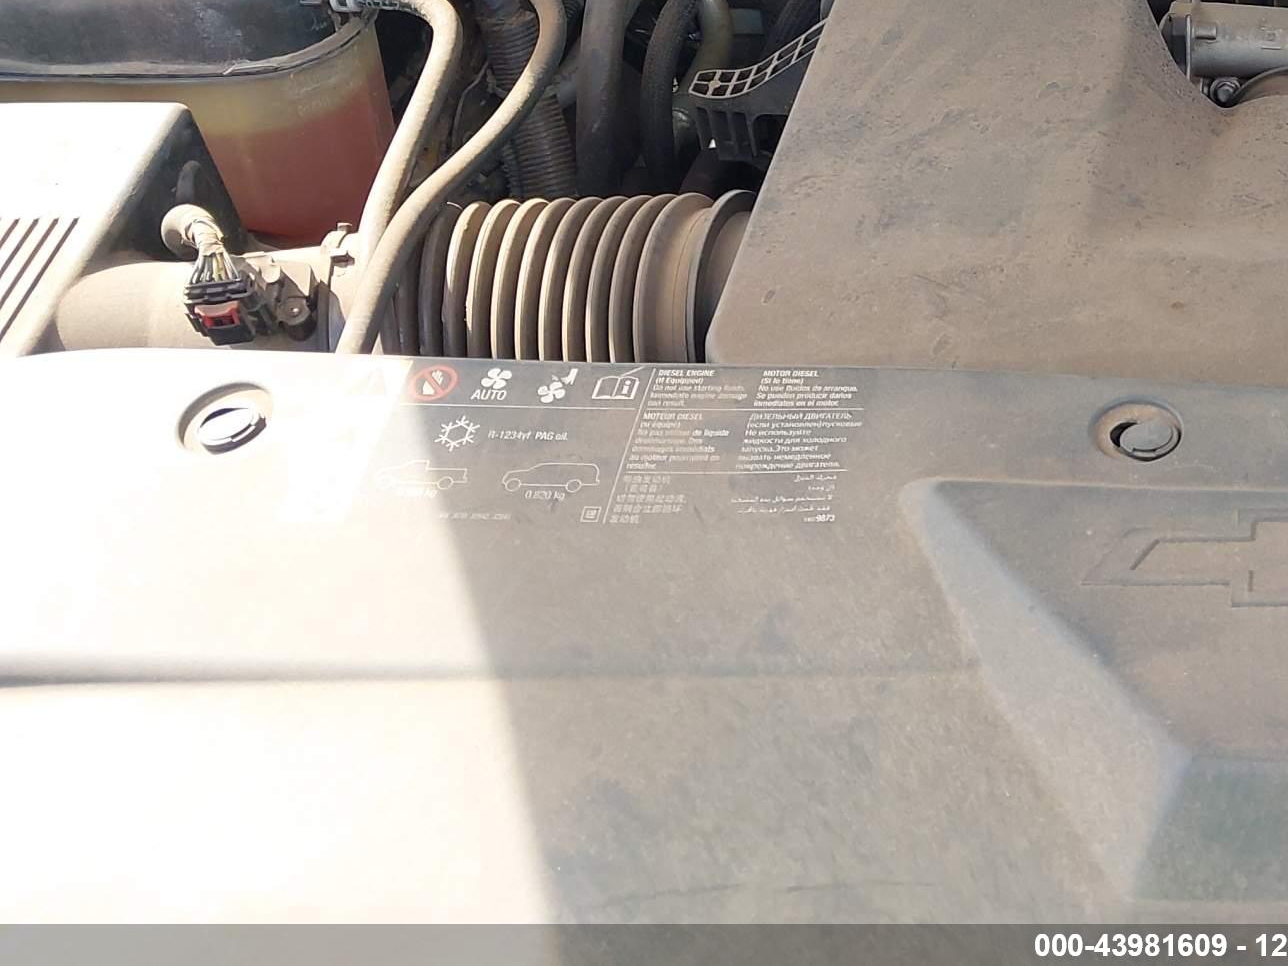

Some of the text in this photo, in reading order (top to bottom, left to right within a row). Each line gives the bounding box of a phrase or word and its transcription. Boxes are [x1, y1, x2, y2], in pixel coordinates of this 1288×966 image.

[658, 369, 717, 377] DIESEL ENGINE
[470, 389, 507, 400] AUTO
[796, 393, 829, 401] producir
[642, 412, 703, 420] MOTEUR DIESEL
[534, 431, 554, 440] PAG
[553, 491, 566, 500] kg
